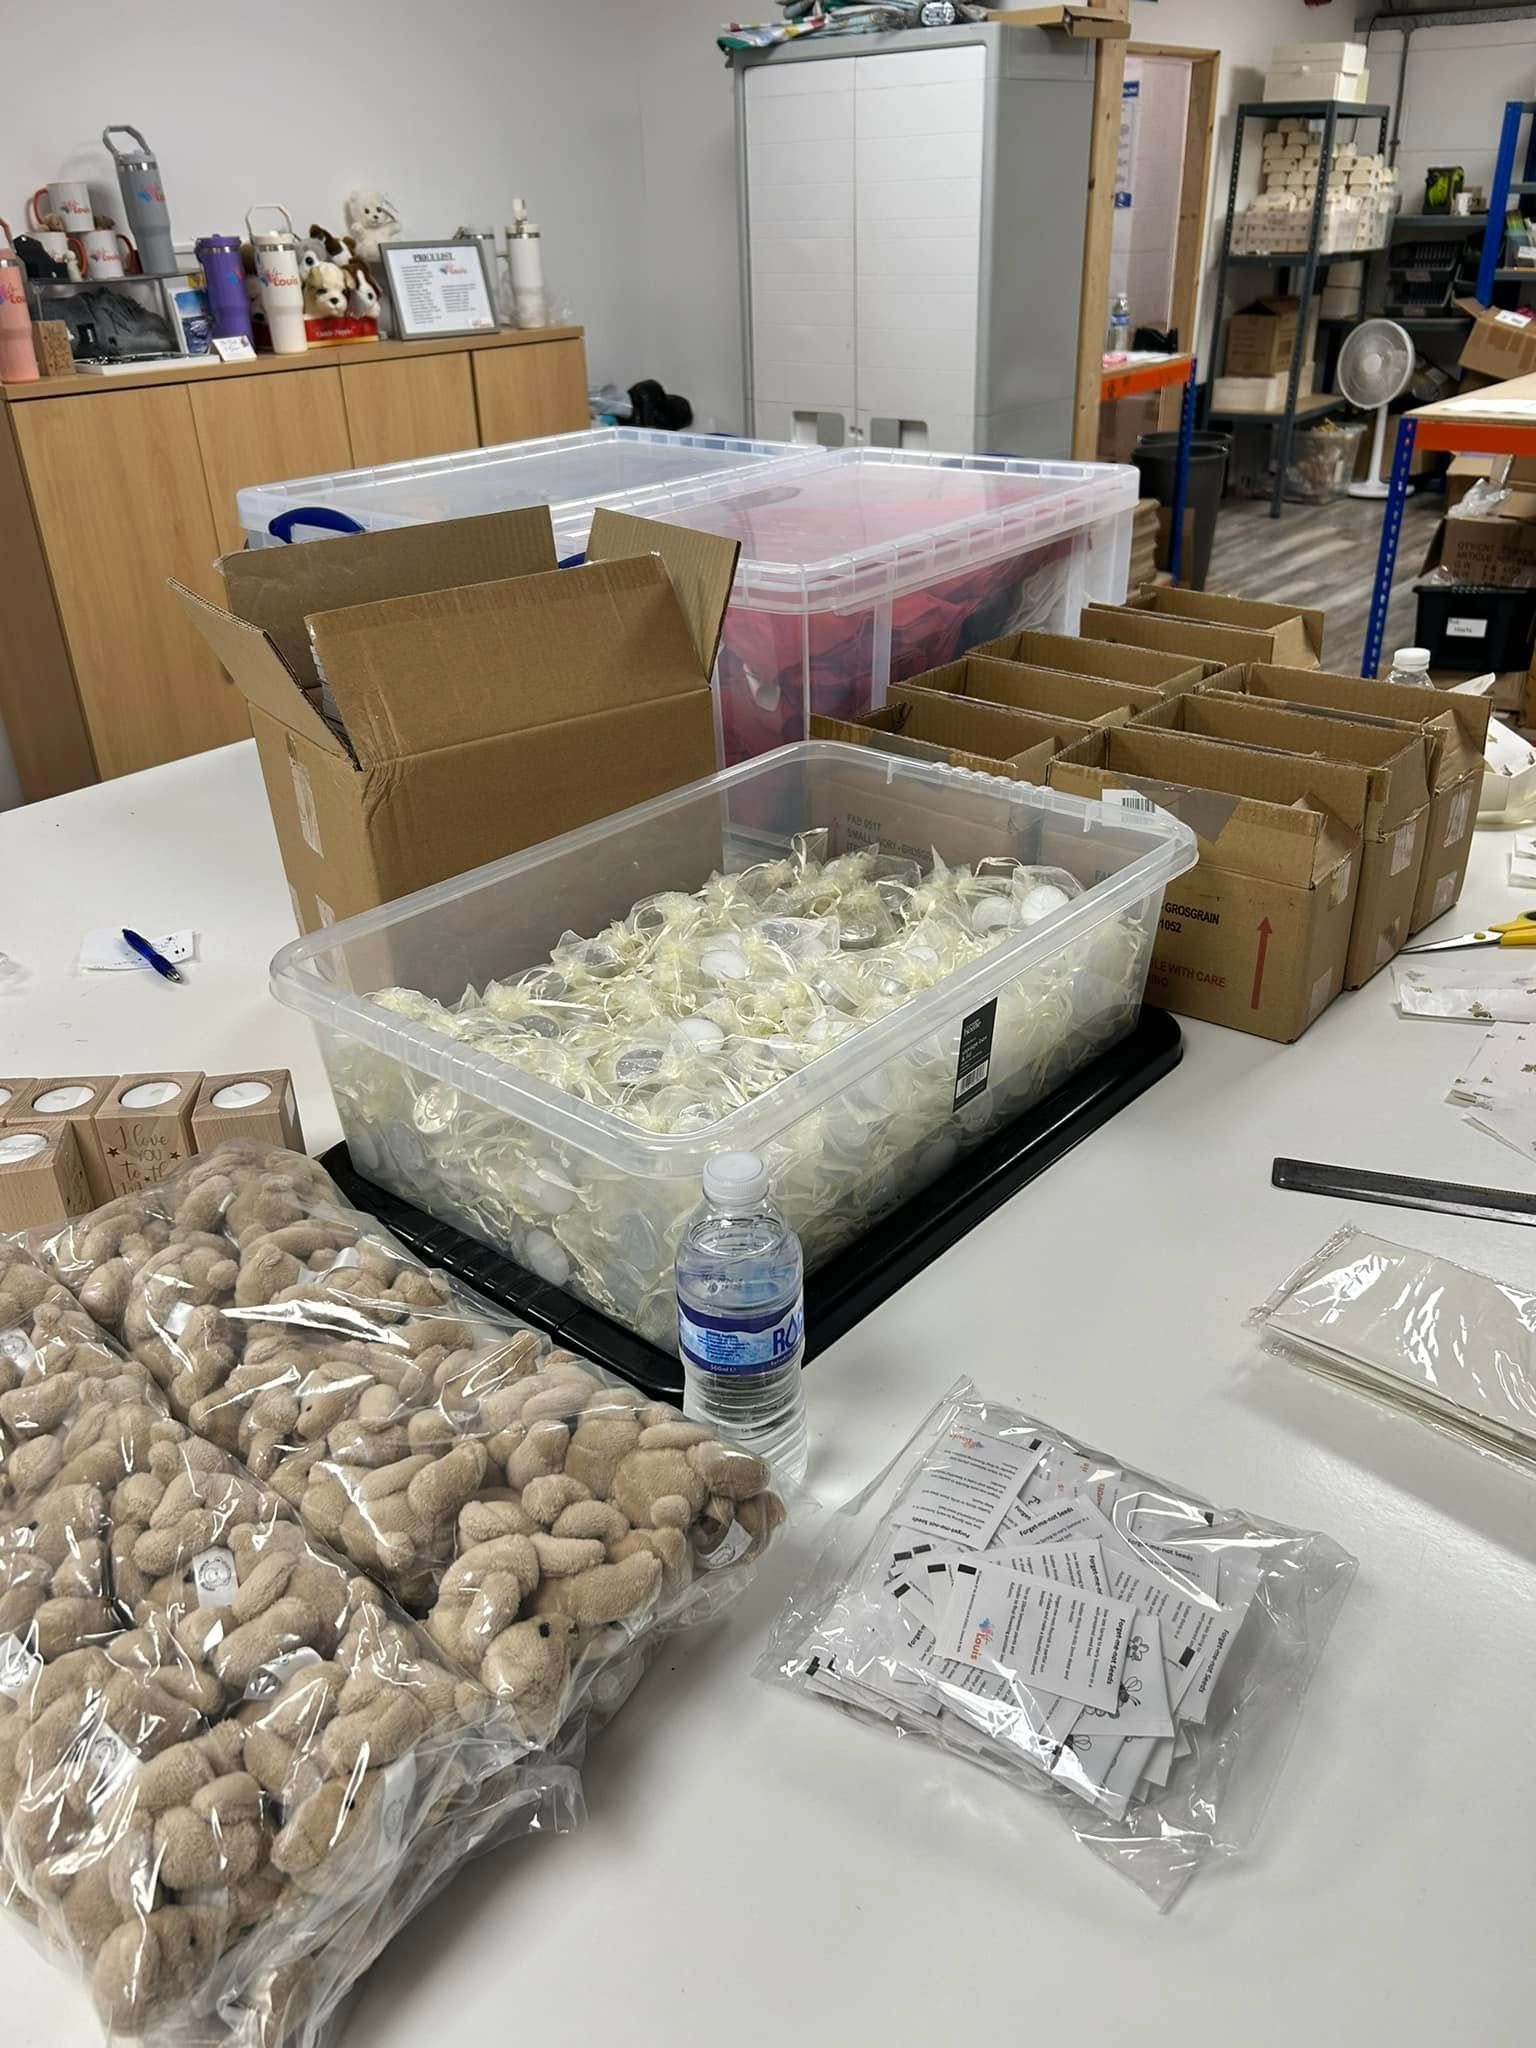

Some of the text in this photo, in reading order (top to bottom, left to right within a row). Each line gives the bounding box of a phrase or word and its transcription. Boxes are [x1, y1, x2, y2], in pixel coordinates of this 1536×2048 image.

[1158, 917, 1183, 933] 1052
[1165, 902, 1219, 925] GROSGRAIN
[1169, 963, 1194, 979] WITH
[1196, 970, 1226, 987] CARE
[132, 1122, 169, 1147] love
[1018, 1507, 1073, 1537] Forget-me-not Seeds
[1174, 1550, 1193, 1561] Seeds
[970, 1633, 984, 1661] Louis
[1106, 1617, 1125, 1684] Forget-me-not Seeds
[1198, 1628, 1229, 1693] Forget-me-not Seeds
